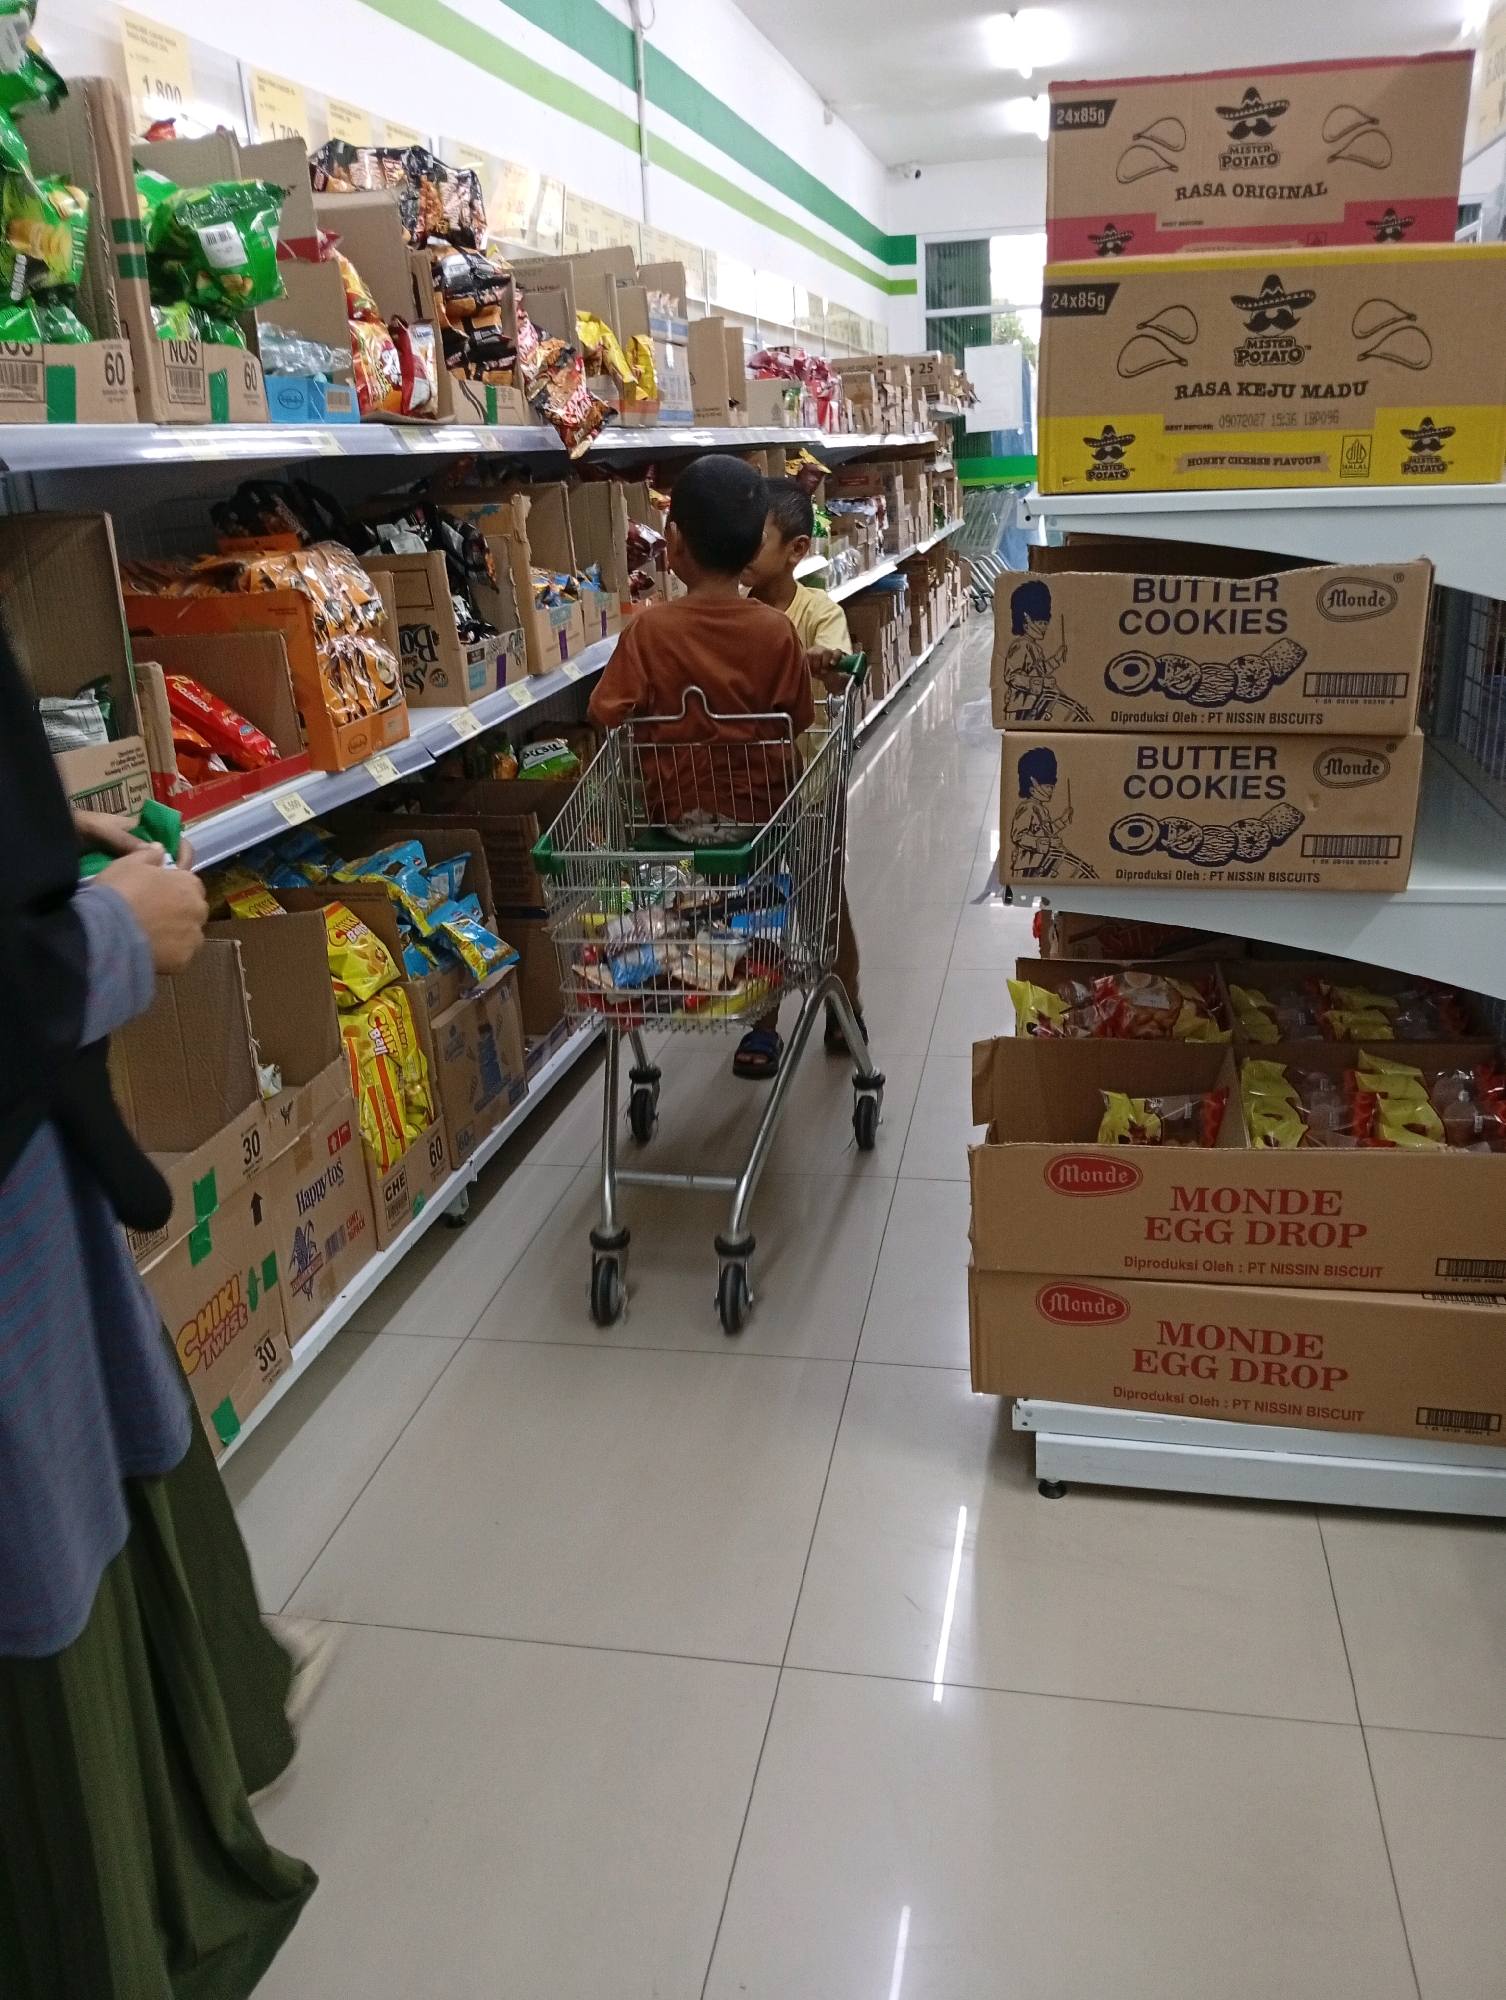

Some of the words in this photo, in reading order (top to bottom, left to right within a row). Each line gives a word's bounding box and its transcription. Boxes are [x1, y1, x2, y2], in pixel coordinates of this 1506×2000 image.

[142, 74, 183, 106] 1800
[1056, 105, 1105, 127] 24x85g
[1221, 152, 1279, 170] POTATO
[1228, 144, 1273, 155] MISTER
[1174, 184, 1227, 201] RASA
[1232, 181, 1328, 200] ORIGINAL
[1050, 292, 1106, 311] 24x85g
[169, 340, 198, 365] NOS
[1244, 337, 1294, 350] MISTER
[104, 351, 126, 386] 60
[918, 362, 934, 374] 25
[1235, 347, 1305, 366] POTATO
[243, 361, 258, 391] 60
[1174, 383, 1232, 400] RASA
[1237, 381, 1296, 399] KEJU
[1300, 380, 1369, 399] MADU
[1218, 412, 1266, 429] 09072027
[1187, 456, 1227, 468] HONEY
[1228, 456, 1271, 466] CHEESE
[1402, 463, 1448, 475] POTATO
[1086, 470, 1130, 481] POTATO
[1322, 590, 1386, 608] Monde
[1118, 608, 1289, 636] COOKIES
[1111, 710, 1169, 725] Diproduksi
[1172, 711, 1198, 724] Oleh
[1207, 711, 1224, 724] PT
[1226, 711, 1266, 725] NISSIN
[1269, 712, 1324, 726] BISCUITS
[1136, 745, 1278, 770] BUTTER
[1323, 758, 1381, 777] Monde
[1123, 774, 1287, 800] COOKIES
[1115, 869, 1172, 883] Diproduksi
[1175, 870, 1200, 882] Oleh
[1209, 870, 1225, 883] PT
[1227, 871, 1266, 883] NISSIN
[1268, 871, 1321, 884] BISCUITS
[242, 1128, 261, 1165] 30
[429, 1135, 443, 1168] 60
[384, 1171, 406, 1202] CHE
[1057, 1164, 1129, 1185] Monde
[1170, 1185, 1343, 1217] MONDE
[1144, 1216, 1235, 1246] EGG
[1245, 1220, 1368, 1250] DROP
[1124, 1255, 1198, 1273] Diproduksi
[1202, 1259, 1234, 1273] Oleh
[1247, 1261, 1267, 1275] PT
[1270, 1262, 1320, 1277] NISSIN
[1323, 1263, 1384, 1279] BISCUIT
[1048, 1292, 1118, 1317] Monde
[176, 1273, 241, 1376] CHIKI
[1156, 1320, 1324, 1360] MONDE
[255, 1336, 277, 1372] 30
[1131, 1348, 1219, 1381] EGG
[1229, 1357, 1349, 1392] DROP
[1113, 1385, 1185, 1404] Diproduksi
[1189, 1391, 1220, 1408] Oleh
[1232, 1398, 1252, 1412] PT
[1254, 1400, 1303, 1417] NISSIN
[1306, 1404, 1365, 1423] BISCUIT
